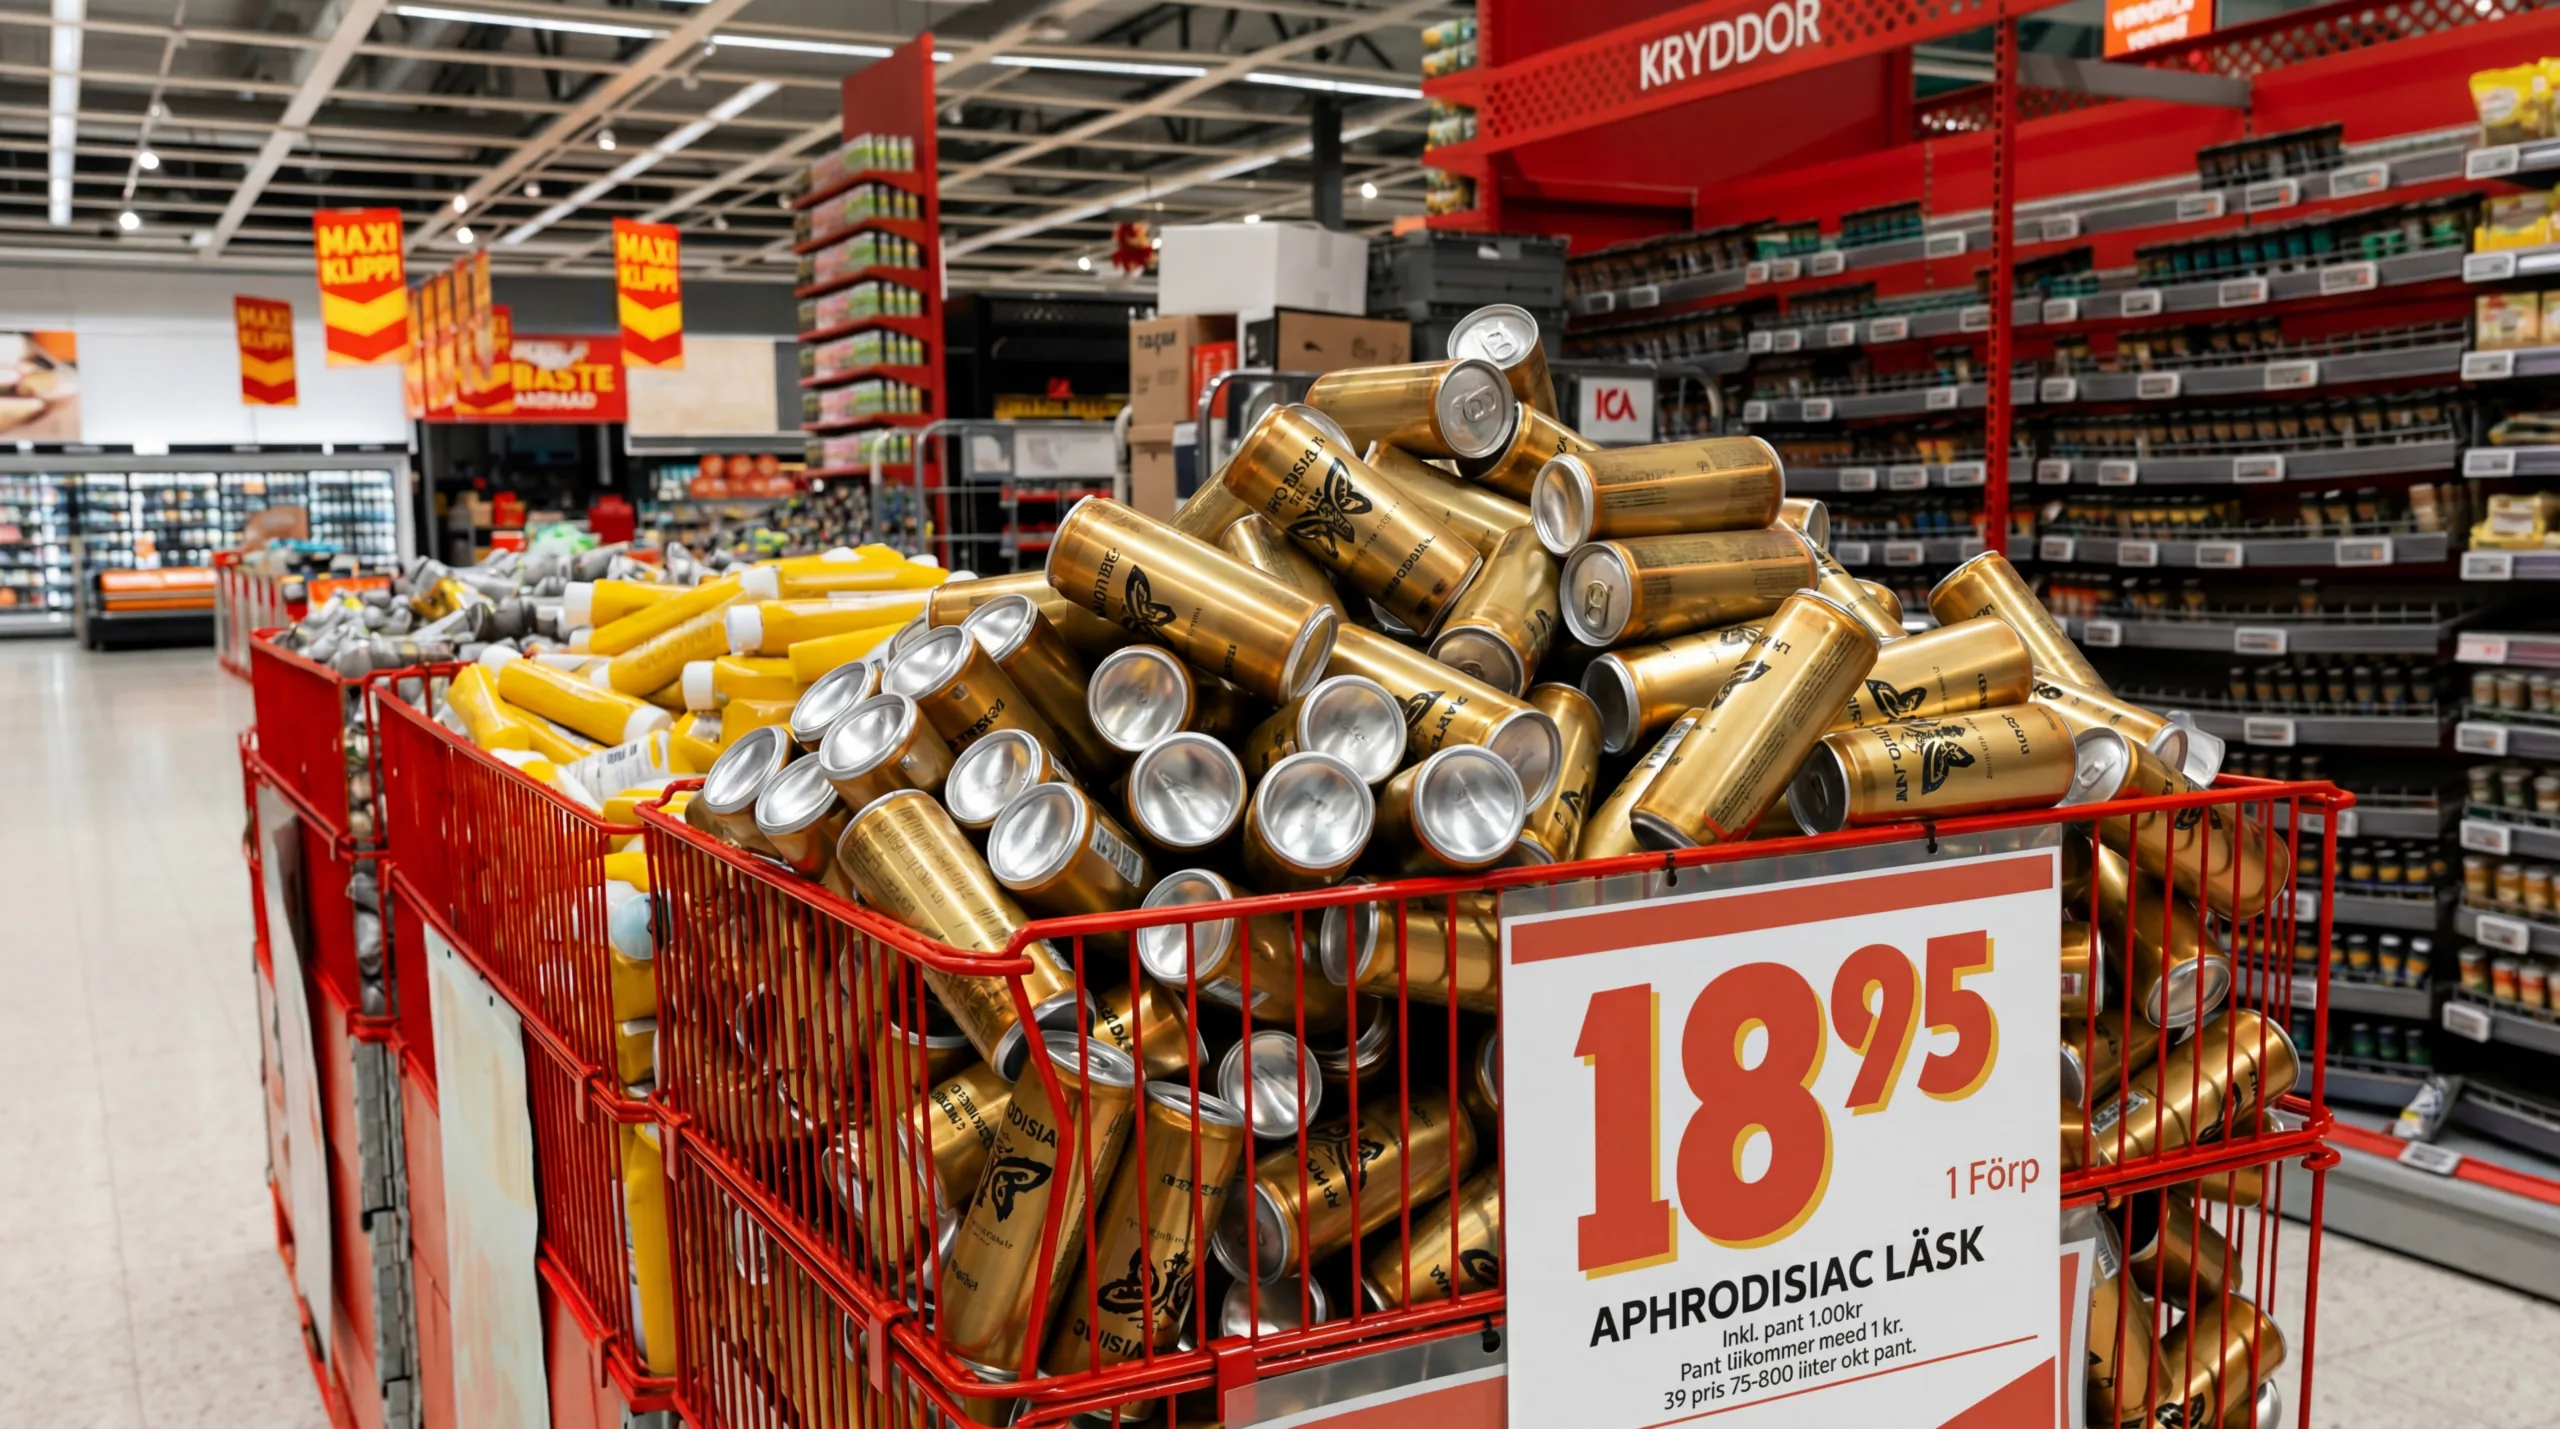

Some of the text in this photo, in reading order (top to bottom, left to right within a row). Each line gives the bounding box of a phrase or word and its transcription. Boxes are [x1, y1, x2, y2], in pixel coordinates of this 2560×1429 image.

[1640, 0, 1822, 90] KRYDDOR
[319, 221, 398, 258] MAXI
[617, 231, 679, 266] MAXI
[1595, 387, 1638, 422] ICA
[1946, 1157, 2041, 1200] 1 Förp
[1588, 1224, 1986, 1348] APHRODISIAC LÄSK
[1722, 1301, 1864, 1348] Inkl. pant 1.00kr
[1680, 1357, 1722, 1382] Pant
[1818, 1322, 1868, 1351] meed
[1871, 1320, 1879, 1339] 1
[1882, 1316, 1905, 1337] kr.
[1664, 1389, 1687, 1411] 39
[1691, 1380, 1726, 1409] pris
[1730, 1363, 1795, 1396] 75-800
[1841, 1346, 1870, 1369] okt
[1874, 1336, 1918, 1368] pant.
